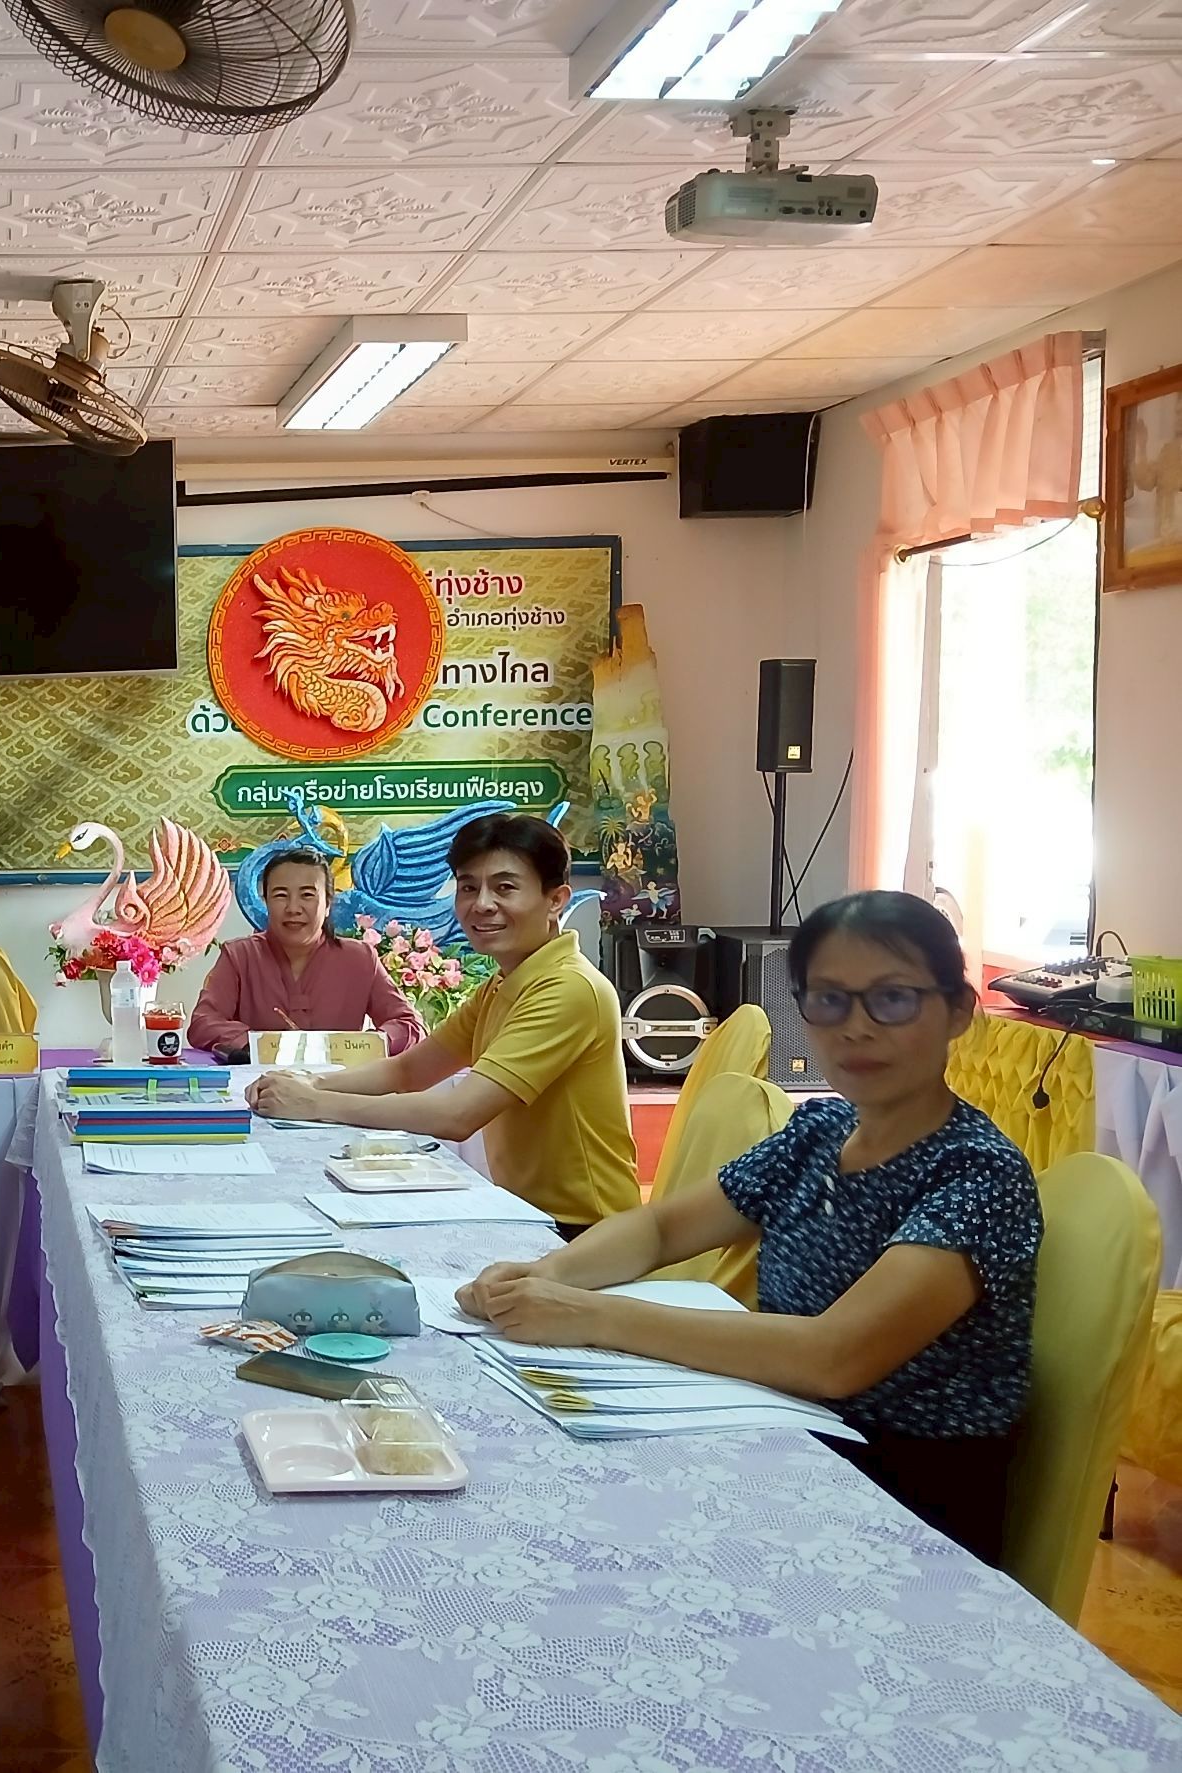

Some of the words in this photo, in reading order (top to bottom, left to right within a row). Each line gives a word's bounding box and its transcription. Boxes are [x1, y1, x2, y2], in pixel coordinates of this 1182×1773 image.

[609, 458, 647, 466] VERTEX
[446, 607, 565, 631] อำเภอทุ่งช้าง
[433, 651, 549, 685] ทางไกล
[422, 703, 593, 728] Conference
